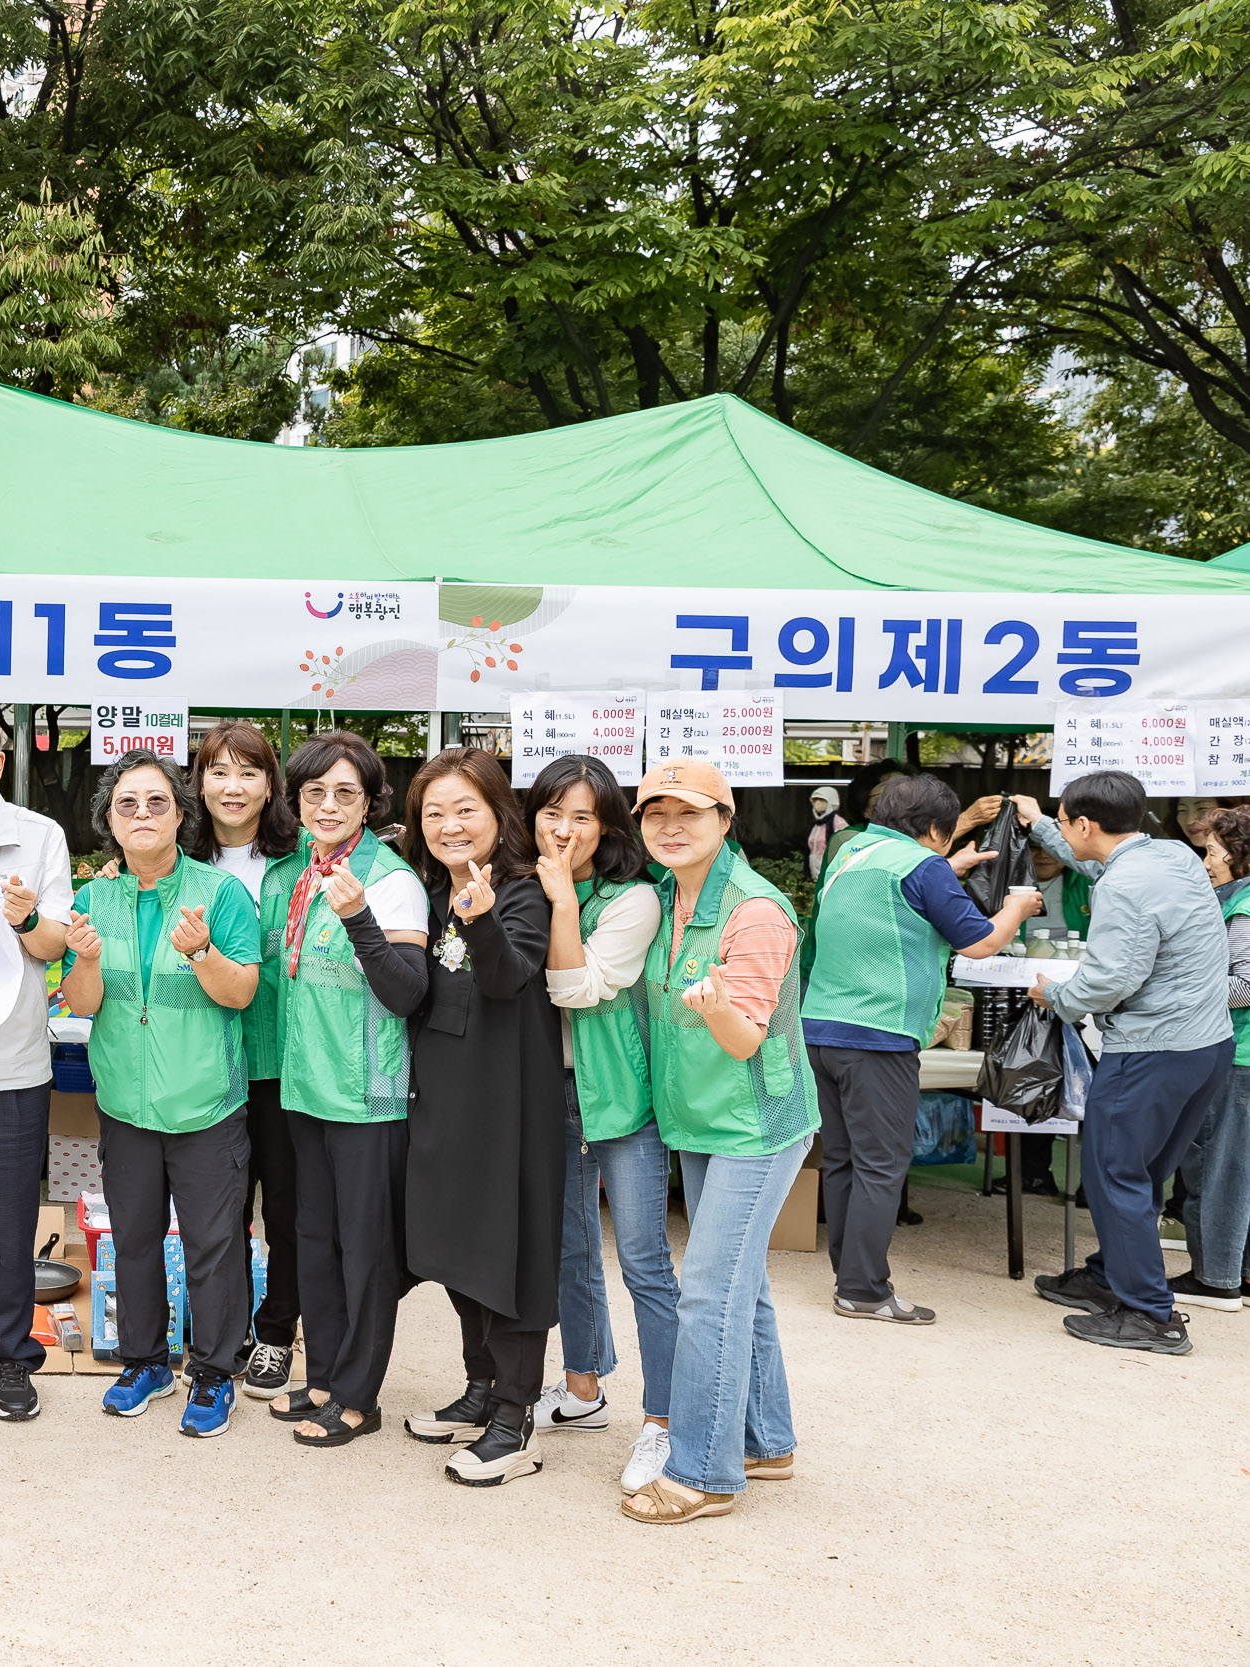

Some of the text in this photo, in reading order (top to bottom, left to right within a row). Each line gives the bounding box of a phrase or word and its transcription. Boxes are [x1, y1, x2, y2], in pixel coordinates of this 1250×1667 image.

[348, 602, 400, 620] 행복광진
[670, 614, 1140, 697] 구의제2동
[592, 708, 635, 720] 6,000원
[723, 706, 773, 718] 25,000원
[144, 713, 183, 728] 10켤레
[1141, 717, 1187, 729] 6,000원
[593, 726, 635, 738] 4,000원
[722, 725, 773, 737] 25,000원
[103, 736, 174, 756] 5,000원
[1142, 736, 1185, 747] 4,000원
[585, 744, 634, 756] 13,000원
[722, 743, 772, 755] 10,000원
[1135, 754, 1185, 766] 13,000원
[312, 944, 330, 954] SMU
[177, 963, 193, 971] SM
